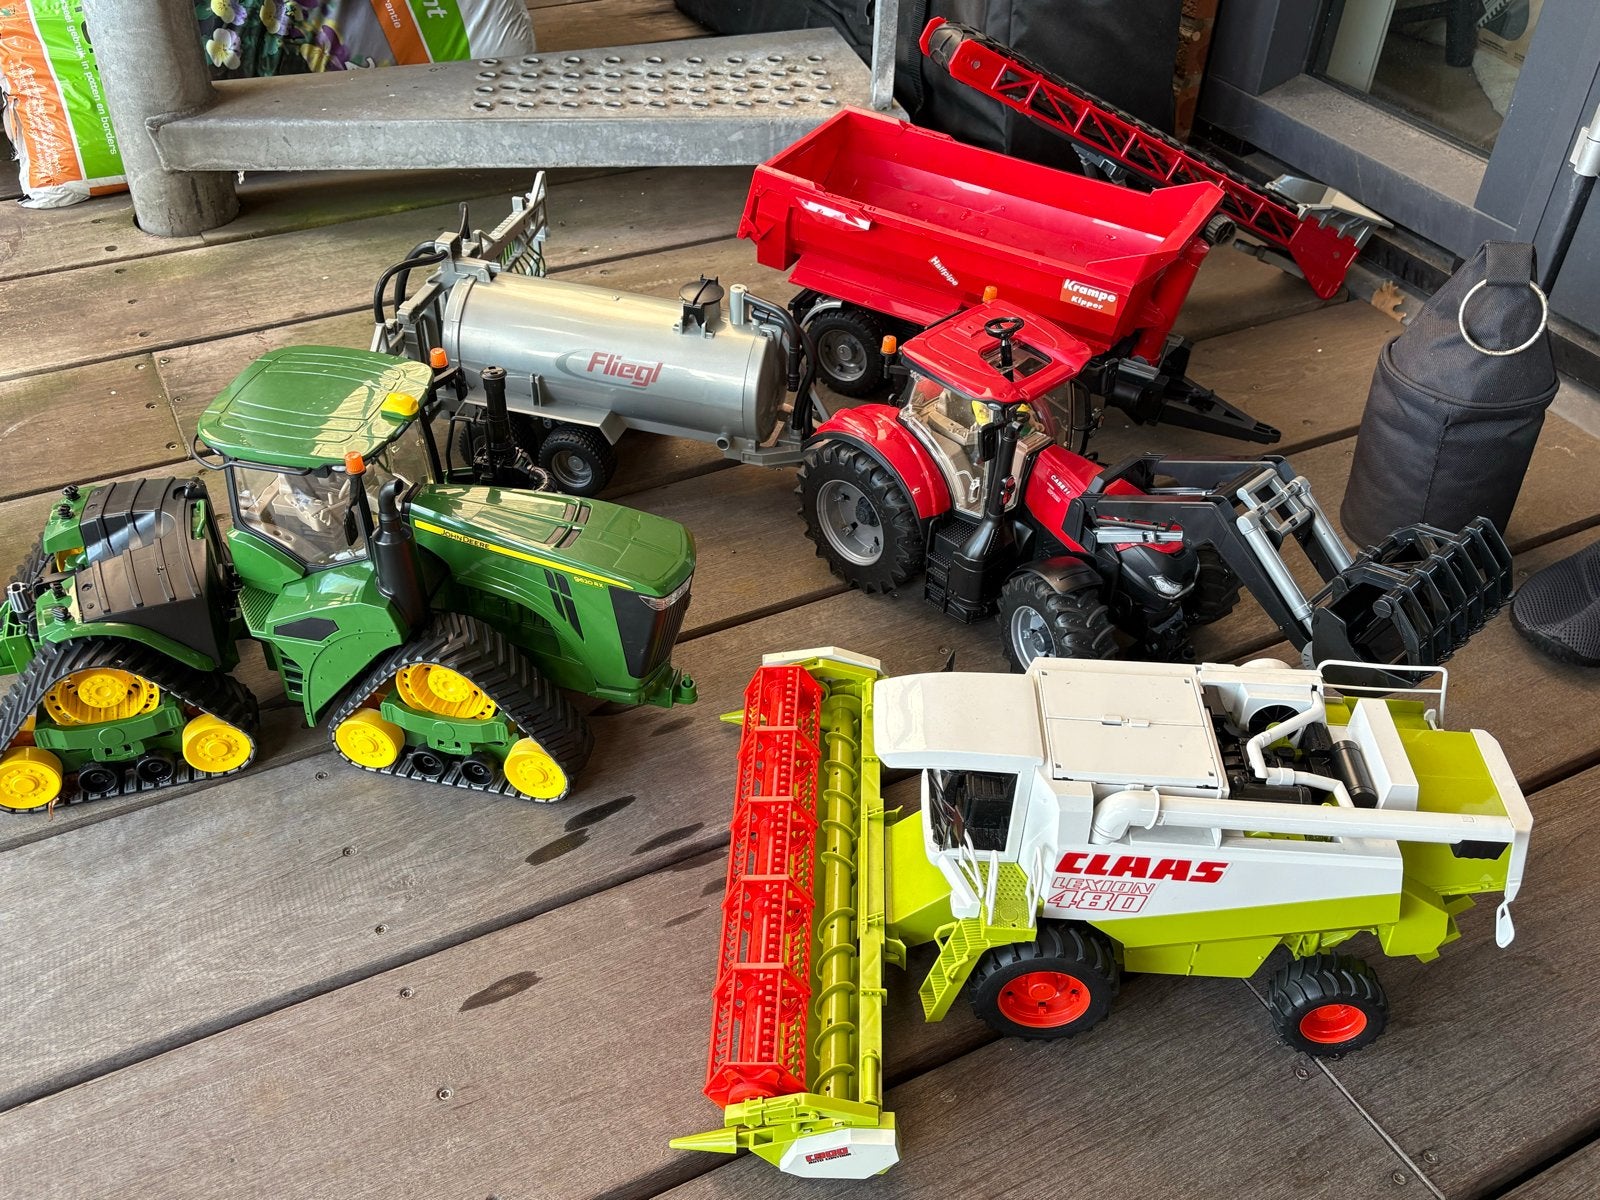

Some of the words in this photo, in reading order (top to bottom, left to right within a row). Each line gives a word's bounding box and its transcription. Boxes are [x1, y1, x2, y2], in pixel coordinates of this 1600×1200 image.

[66, 25, 86, 60] gebruik
[81, 60, 90, 70] in
[84, 71, 101, 101] potten
[96, 103, 106, 115] en
[101, 116, 117, 155] borders
[930, 255, 959, 286] Halfpipe
[1063, 278, 1117, 303] Krampe
[1070, 295, 1104, 310] Kipper
[587, 351, 664, 387] Fliegl
[463, 535, 490, 550] DEERE
[1055, 852, 1229, 884] CLAAS
[1052, 876, 1156, 895] LEXION
[1047, 889, 1149, 913] 480
